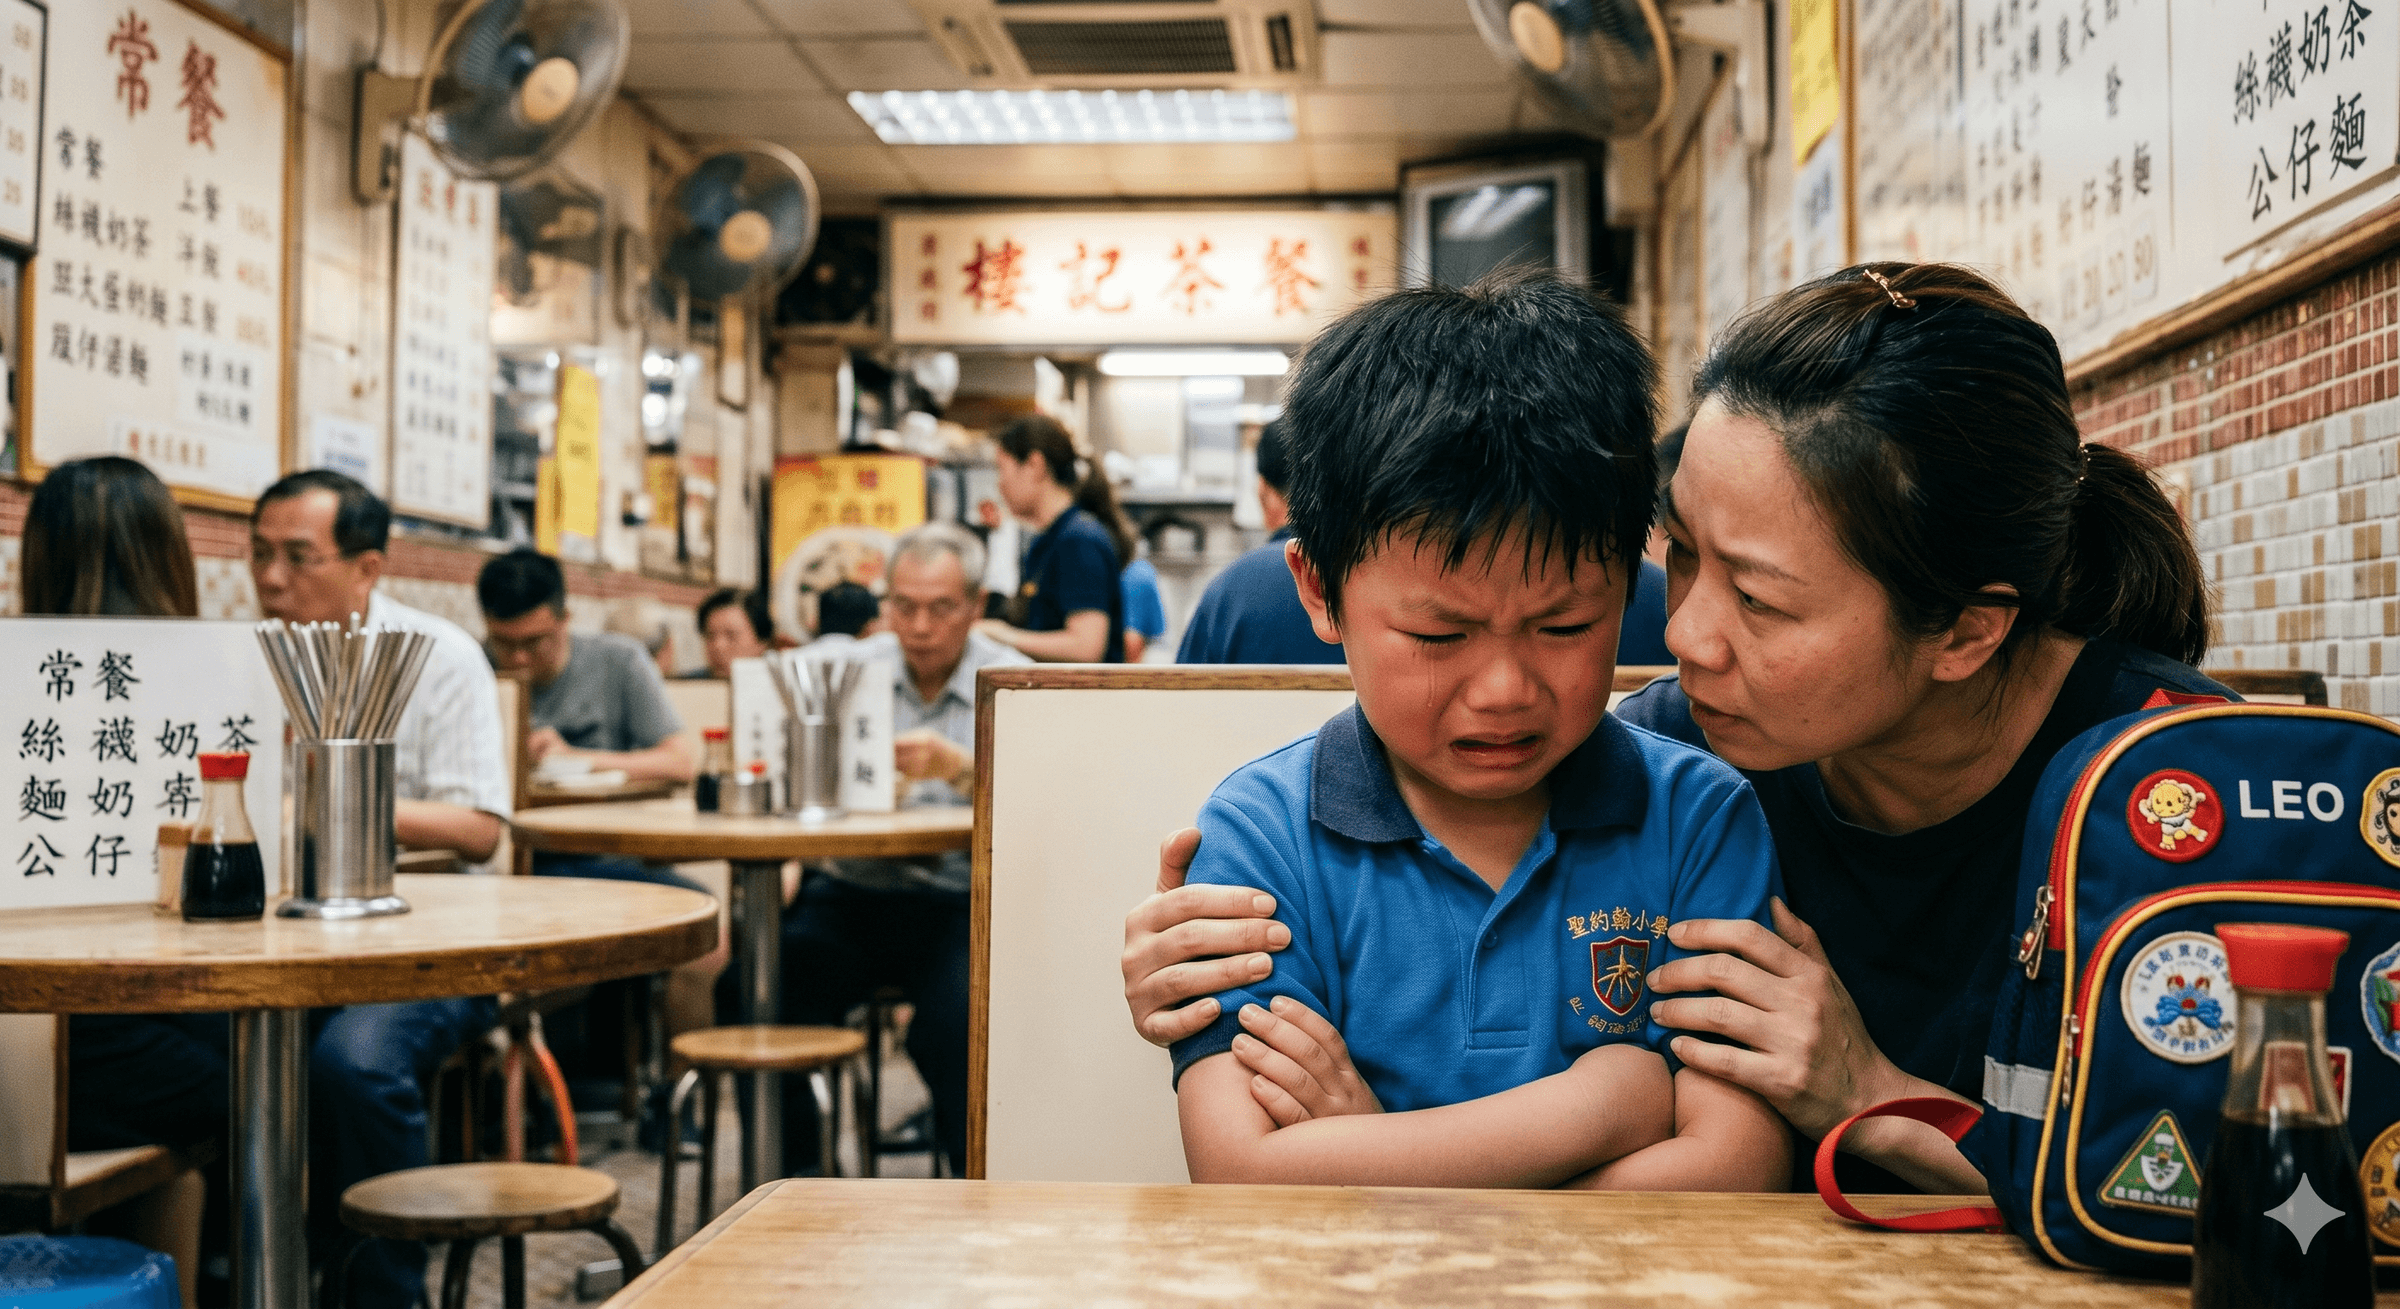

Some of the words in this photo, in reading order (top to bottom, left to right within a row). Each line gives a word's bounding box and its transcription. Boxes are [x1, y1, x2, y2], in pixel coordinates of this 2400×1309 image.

[106, 8, 226, 151] 常餐
[2248, 92, 2368, 222] 公仔麵
[39, 649, 142, 702] 常餐
[18, 714, 261, 764] 絲襪奶茶
[2238, 779, 2345, 823] LEO
[1566, 905, 1669, 940] 聖約翰小學
